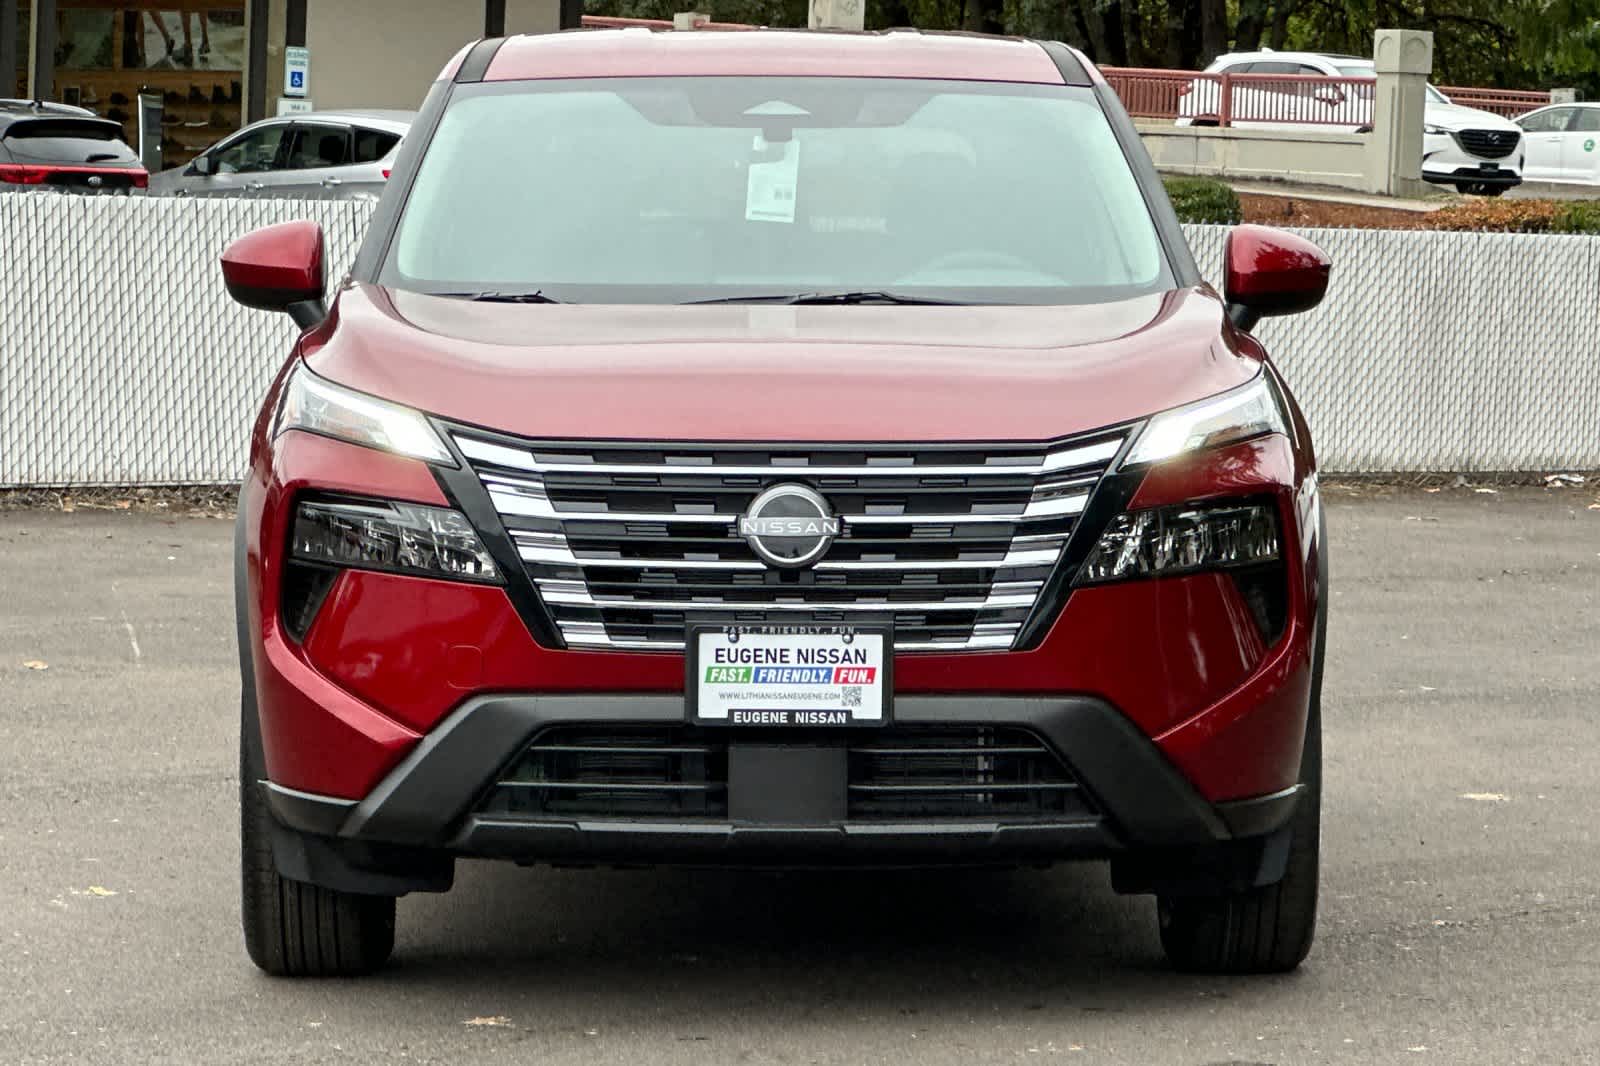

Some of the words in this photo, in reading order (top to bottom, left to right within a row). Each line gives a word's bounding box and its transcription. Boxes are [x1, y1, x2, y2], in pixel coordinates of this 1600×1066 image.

[743, 521, 837, 533] NISSAN
[715, 648, 790, 663] EUGENE
[797, 649, 867, 664] NISSAN
[710, 668, 748, 682] FAST.
[758, 668, 829, 682] FRIENDLY.
[838, 669, 872, 683] FUN.
[733, 712, 788, 723] EUGENE
[795, 712, 847, 724] NISSAN
